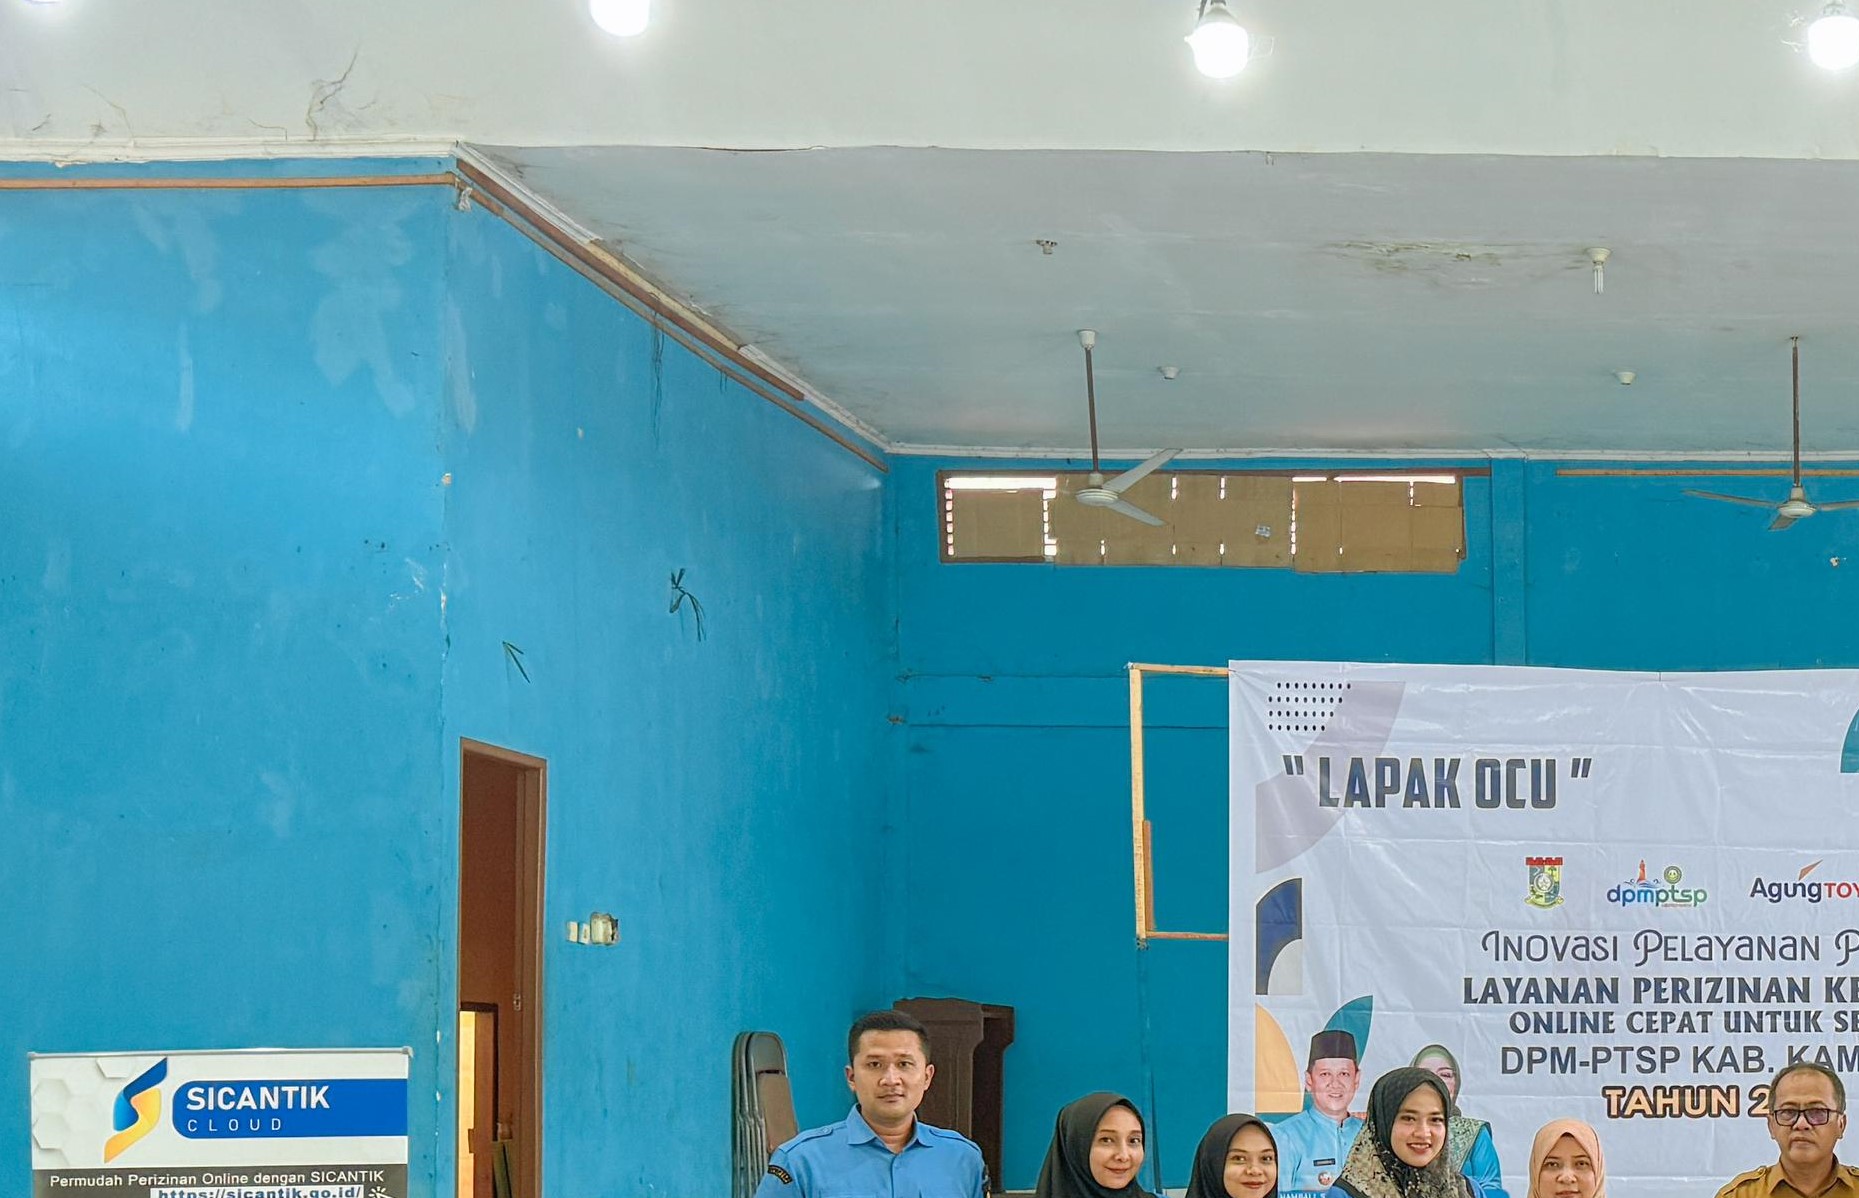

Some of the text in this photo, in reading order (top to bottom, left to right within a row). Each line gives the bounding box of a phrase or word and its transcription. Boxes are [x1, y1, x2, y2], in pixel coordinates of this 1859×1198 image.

[1317, 756, 1557, 810] LAPAK OCU
[1464, 976, 1618, 1006] LAYANAN
[1633, 976, 1809, 1005] PERIZINAN
[1509, 1009, 1615, 1036] ONLINE
[1626, 1009, 1713, 1035] CEPAT
[1723, 1008, 1823, 1034] UNTUK
[1501, 1046, 1680, 1075] DPM-PTSP
[1693, 1045, 1773, 1074] KAB.
[186, 1086, 329, 1110] SICANTIK
[1602, 1085, 1740, 1118] TAHUN
[186, 1119, 282, 1132] CLOUD
[50, 1170, 383, 1188] Permudah Perizinan Online dengan SICANTIK
